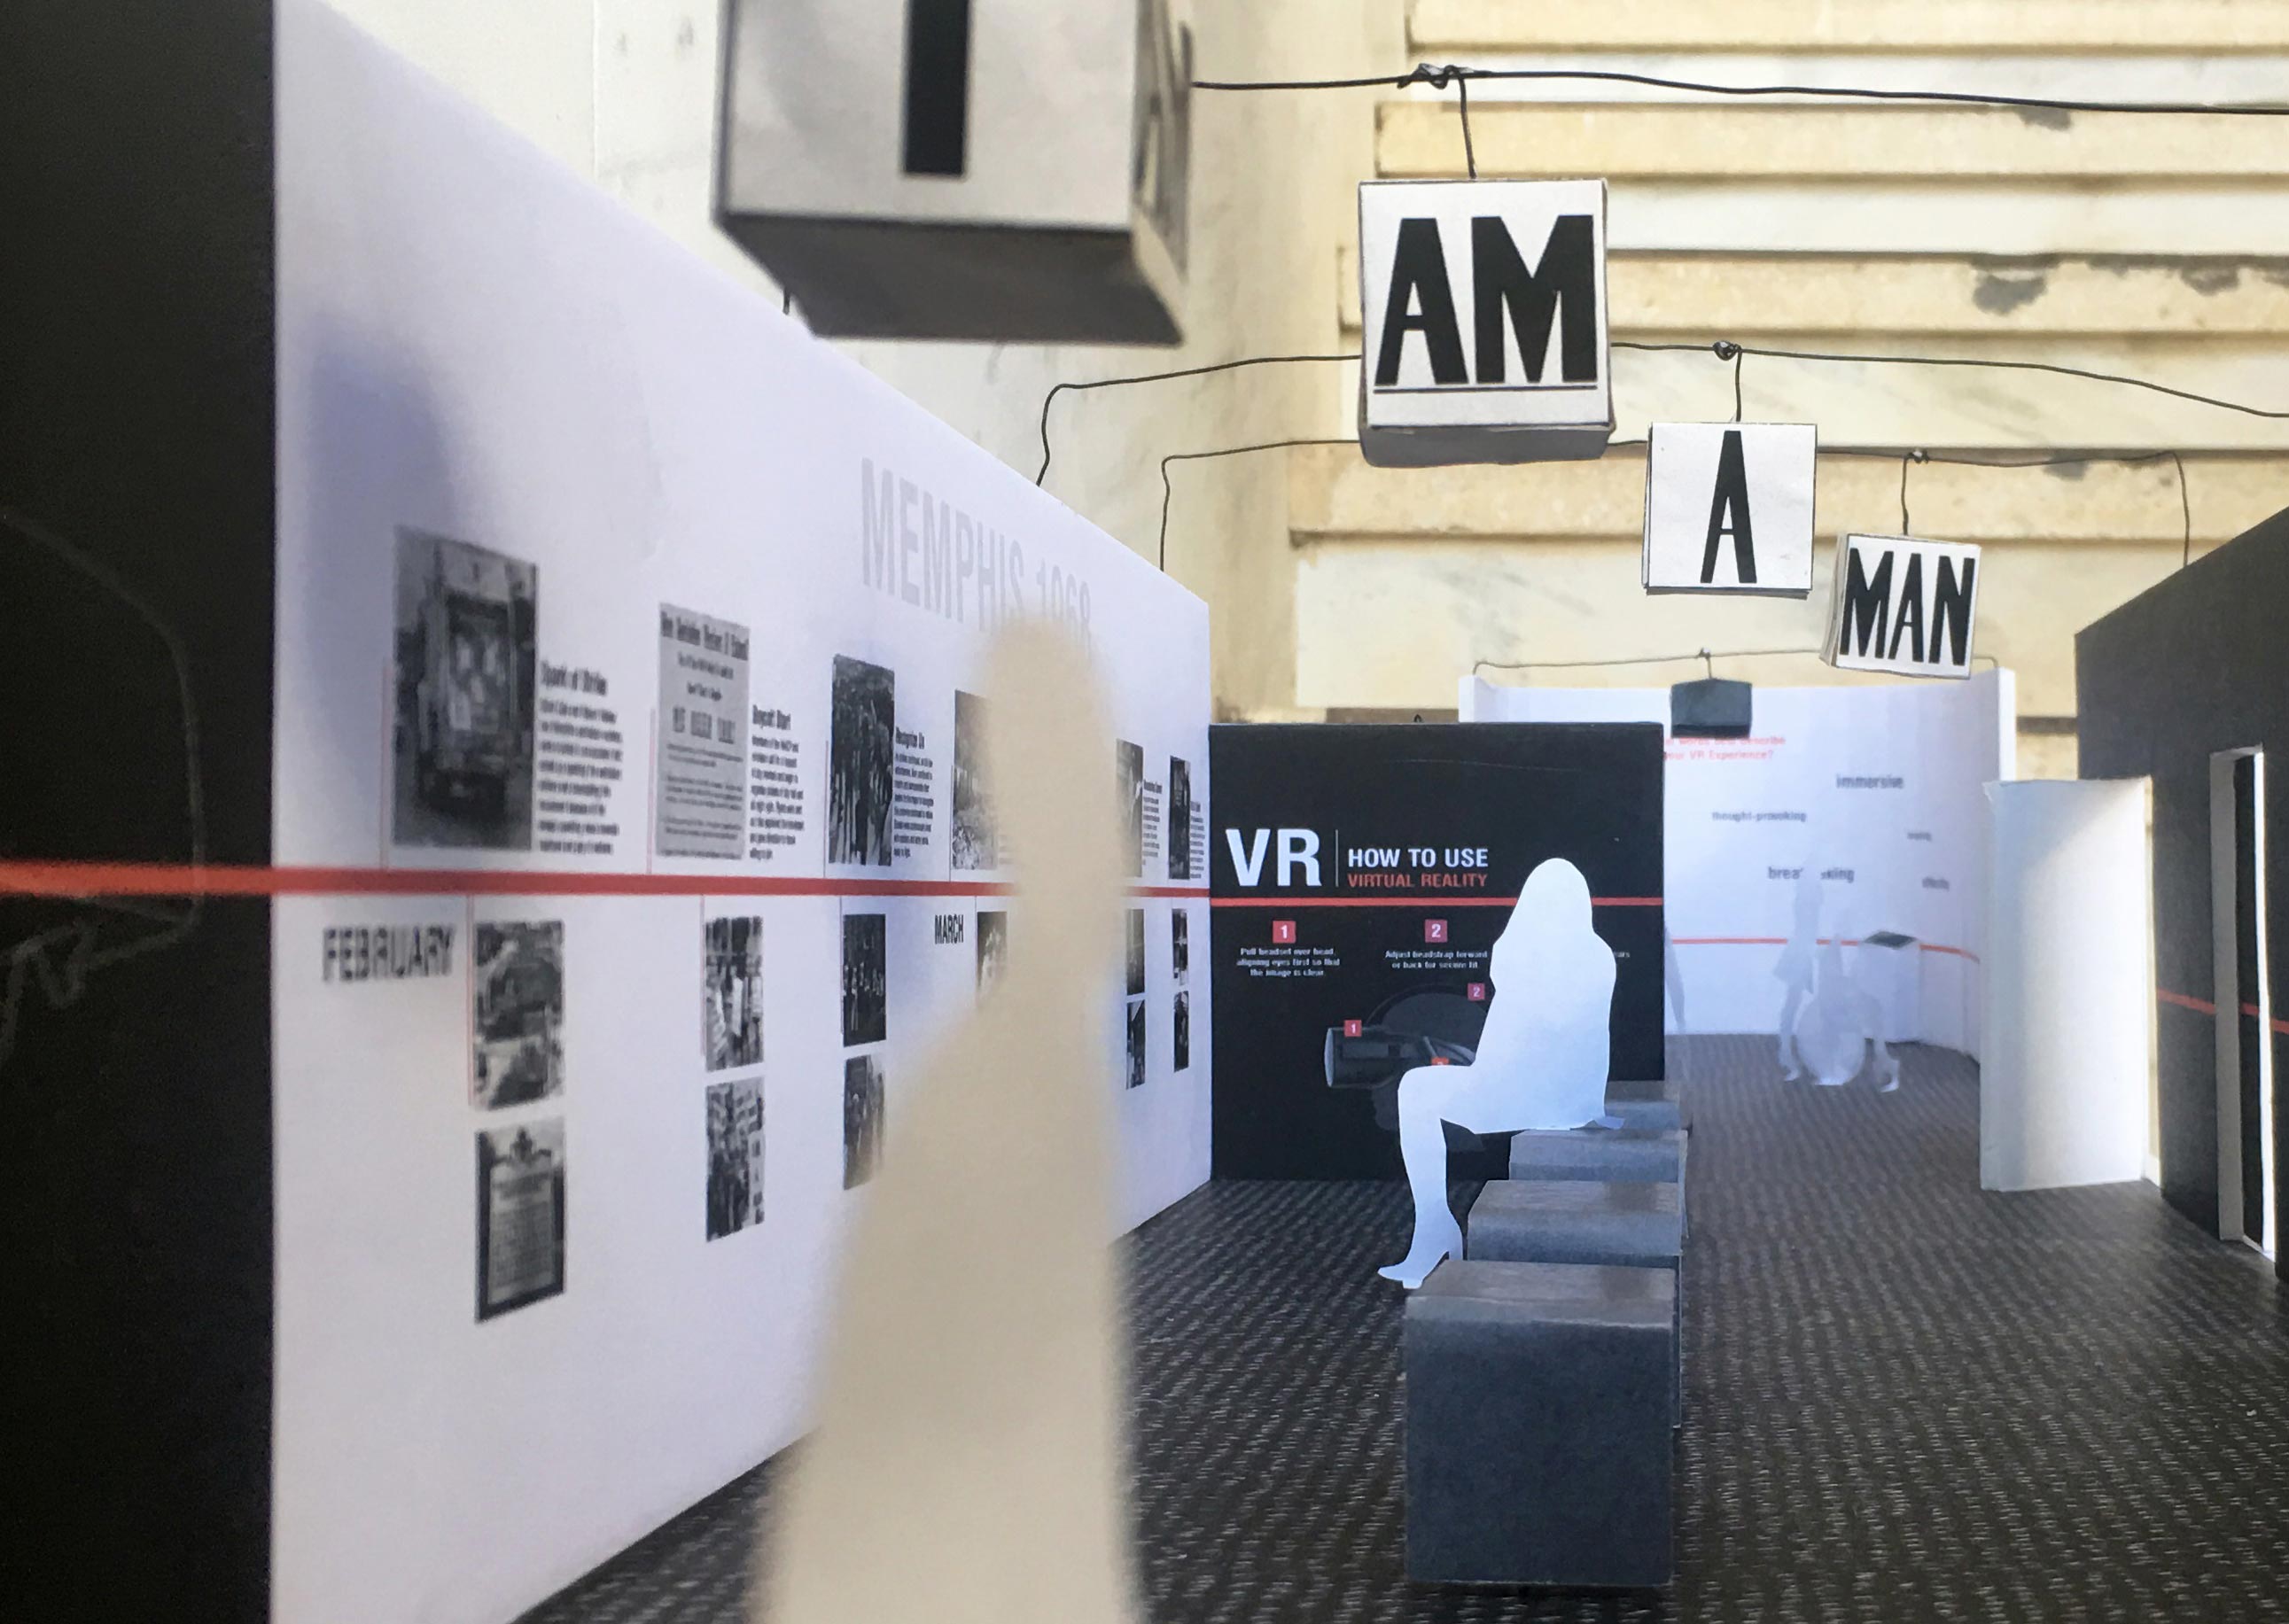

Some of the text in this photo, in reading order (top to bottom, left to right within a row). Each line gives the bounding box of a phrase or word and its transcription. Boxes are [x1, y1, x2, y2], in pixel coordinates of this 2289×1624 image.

[1374, 214, 1597, 385] AM
[1701, 431, 1757, 584] A
[861, 457, 1025, 633] MEMPHIS
[1839, 548, 1975, 666] MAN
[1709, 750, 1772, 761] Experience?
[1836, 773, 1904, 789] immersive
[1226, 828, 1322, 887] VR
[1348, 848, 1489, 867] HOW TO USE
[1347, 874, 1488, 888] VIRTUAL REALITY
[935, 914, 964, 944] MARCH
[1281, 925, 1288, 938] 1
[1431, 923, 1442, 938] 2
[323, 925, 455, 982] FEBRUARY
[1385, 950, 1411, 960] Adjust
[1413, 950, 1454, 960] headstrap
